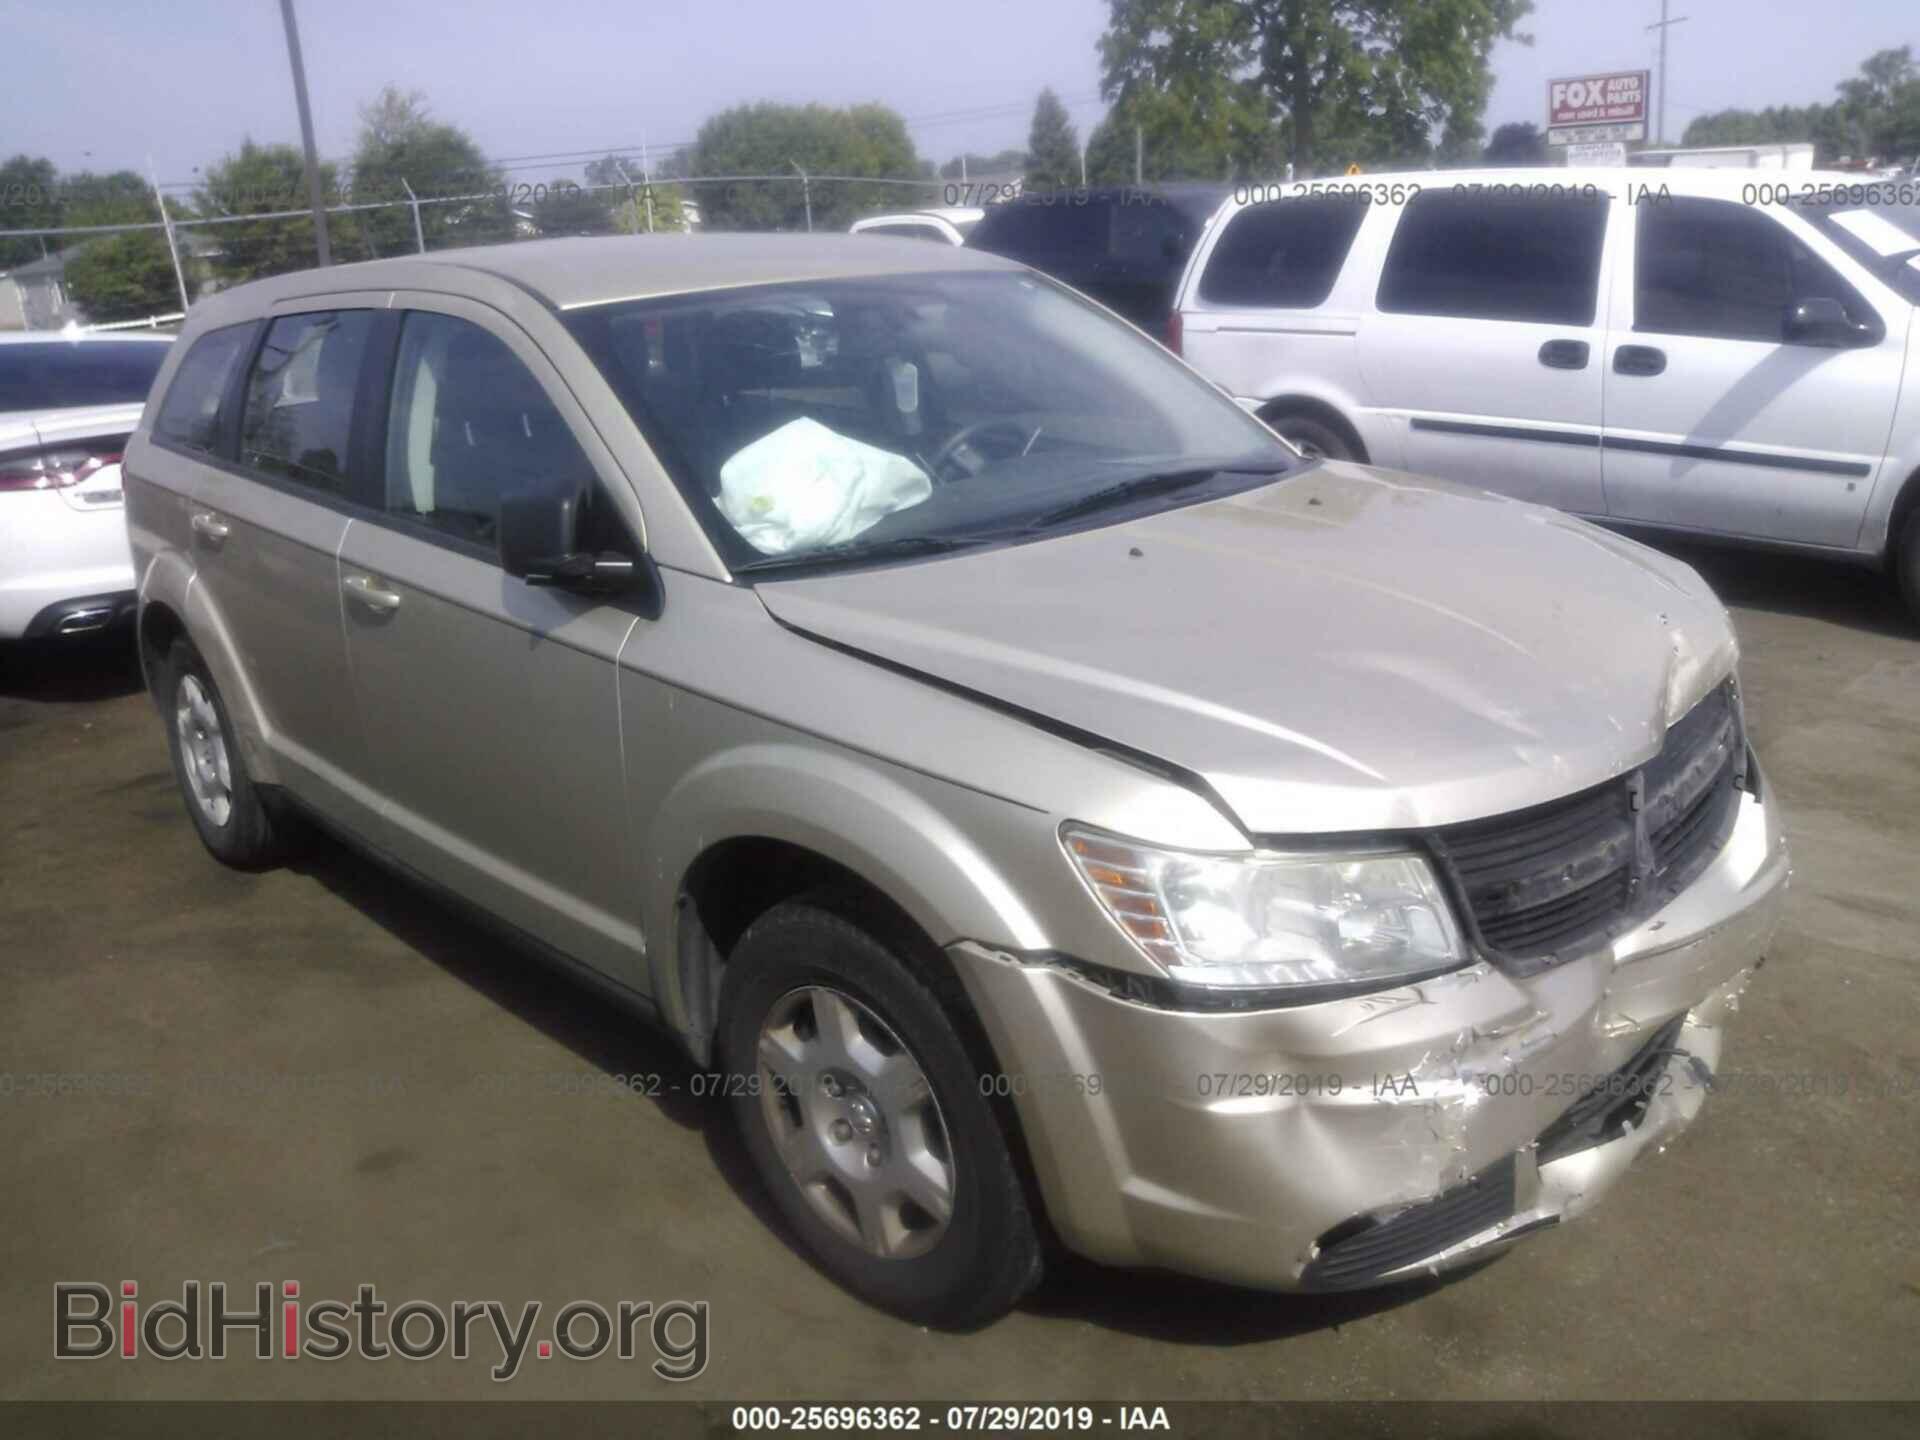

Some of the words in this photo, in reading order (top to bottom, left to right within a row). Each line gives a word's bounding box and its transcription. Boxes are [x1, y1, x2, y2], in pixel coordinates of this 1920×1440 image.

[1608, 76, 1639, 91] AUTO
[1552, 80, 1605, 109] FOX
[1607, 90, 1641, 105] PARTS
